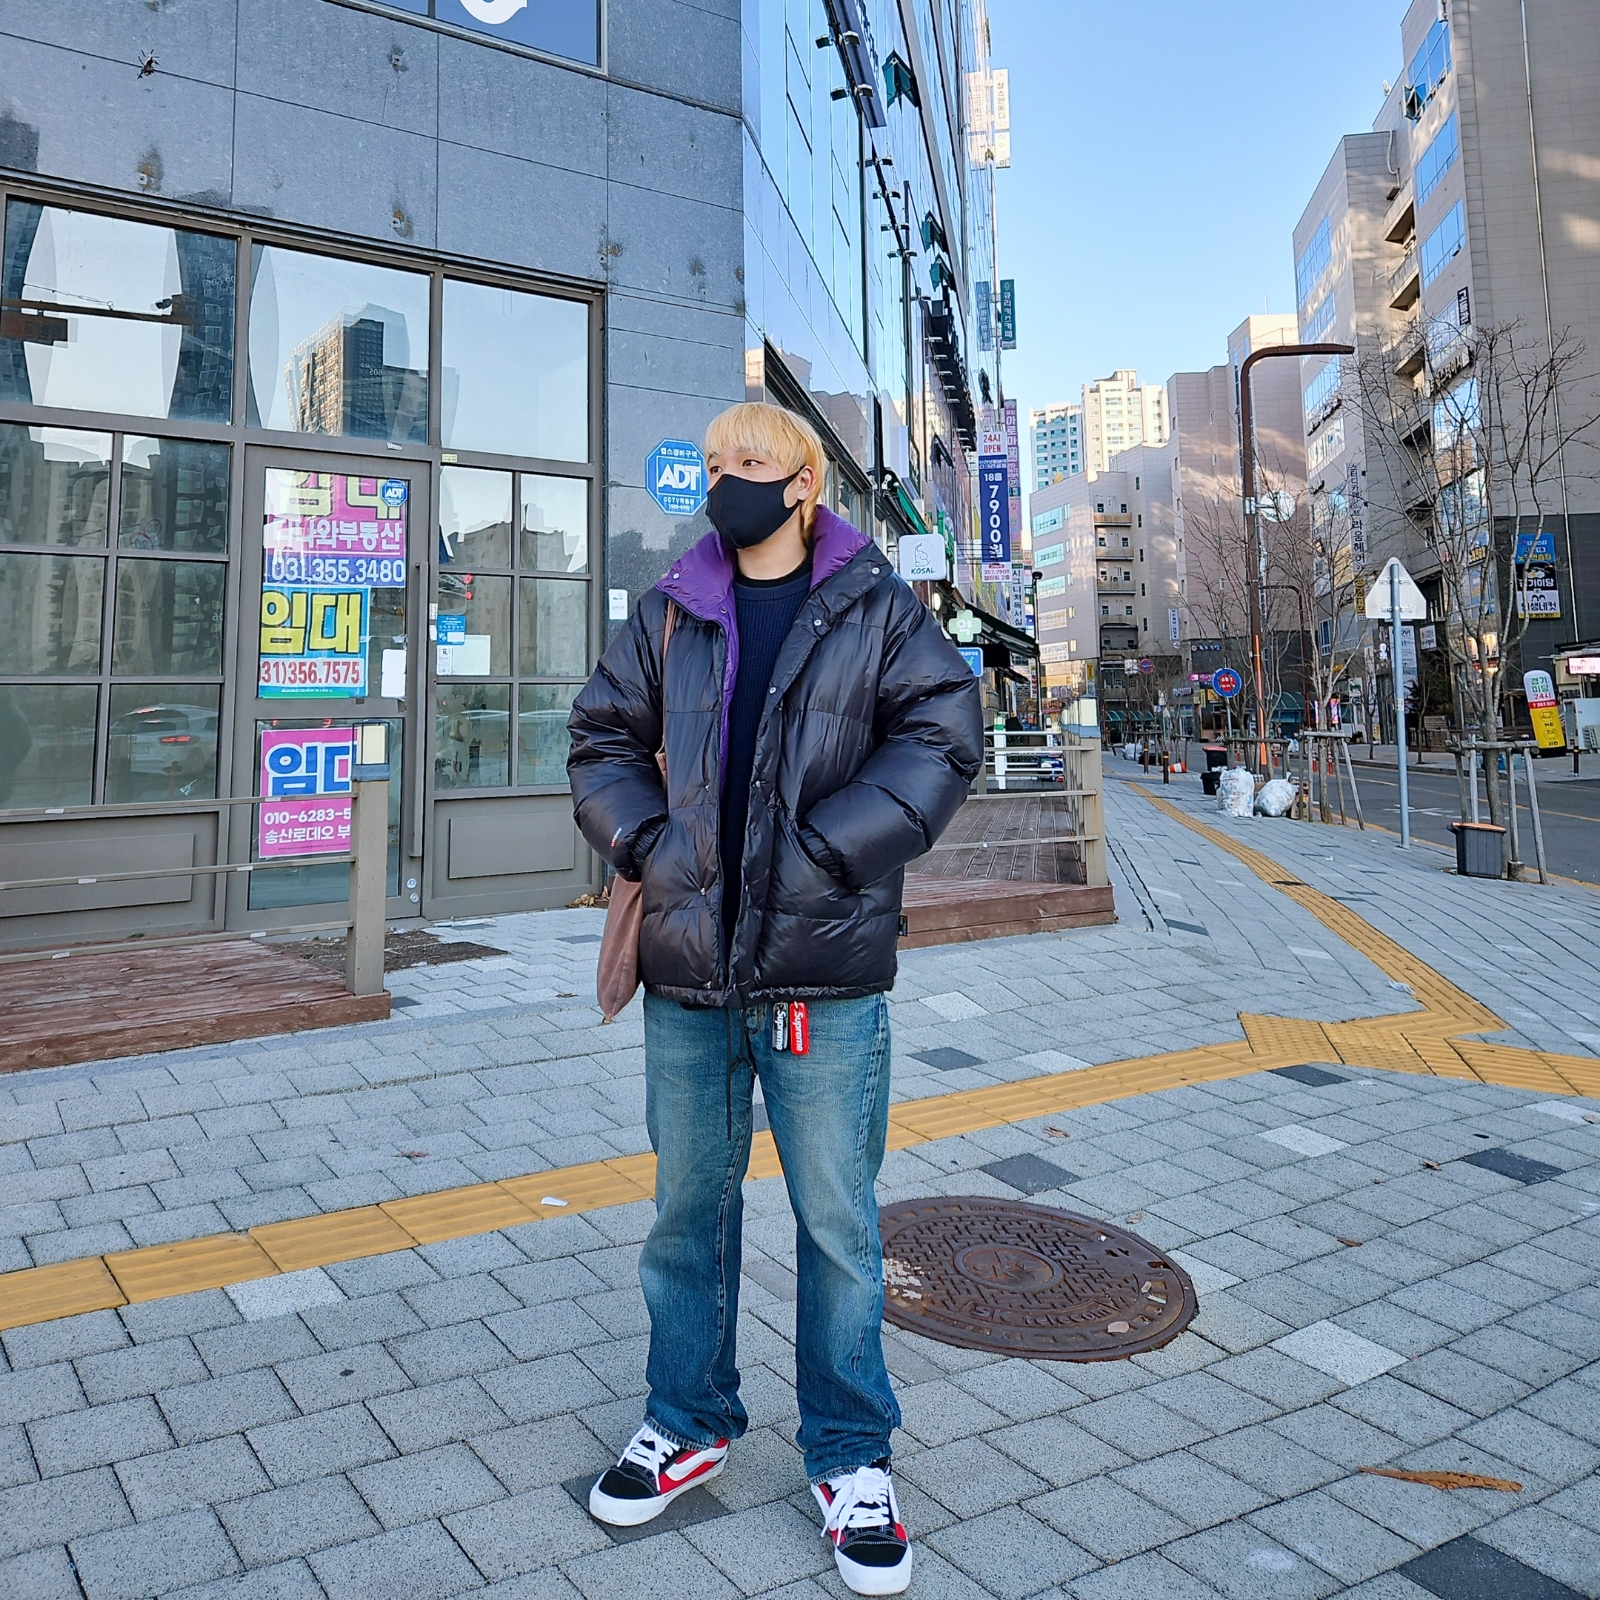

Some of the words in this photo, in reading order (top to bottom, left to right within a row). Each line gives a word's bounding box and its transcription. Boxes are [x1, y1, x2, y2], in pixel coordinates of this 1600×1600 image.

[983, 434, 1001, 443] 24시
[1005, 416, 1017, 446] 아로마
[983, 444, 1001, 454] OPEN
[658, 464, 700, 491] ADT
[983, 472, 1002, 482] 18홀
[385, 487, 404, 499] ADT
[910, 567, 936, 575] KOSAL
[1012, 569, 1023, 626] 시그니처독서실
[260, 591, 363, 655] 임대
[956, 619, 973, 636] 약
[259, 660, 361, 686] 31)356.7575
[264, 825, 334, 845] 송산로데오
[775, 1010, 786, 1050] Supreme
[792, 1010, 804, 1051] Supreme
[971, 1304, 1013, 1322] SK
[1023, 1306, 1112, 1326] telecom
